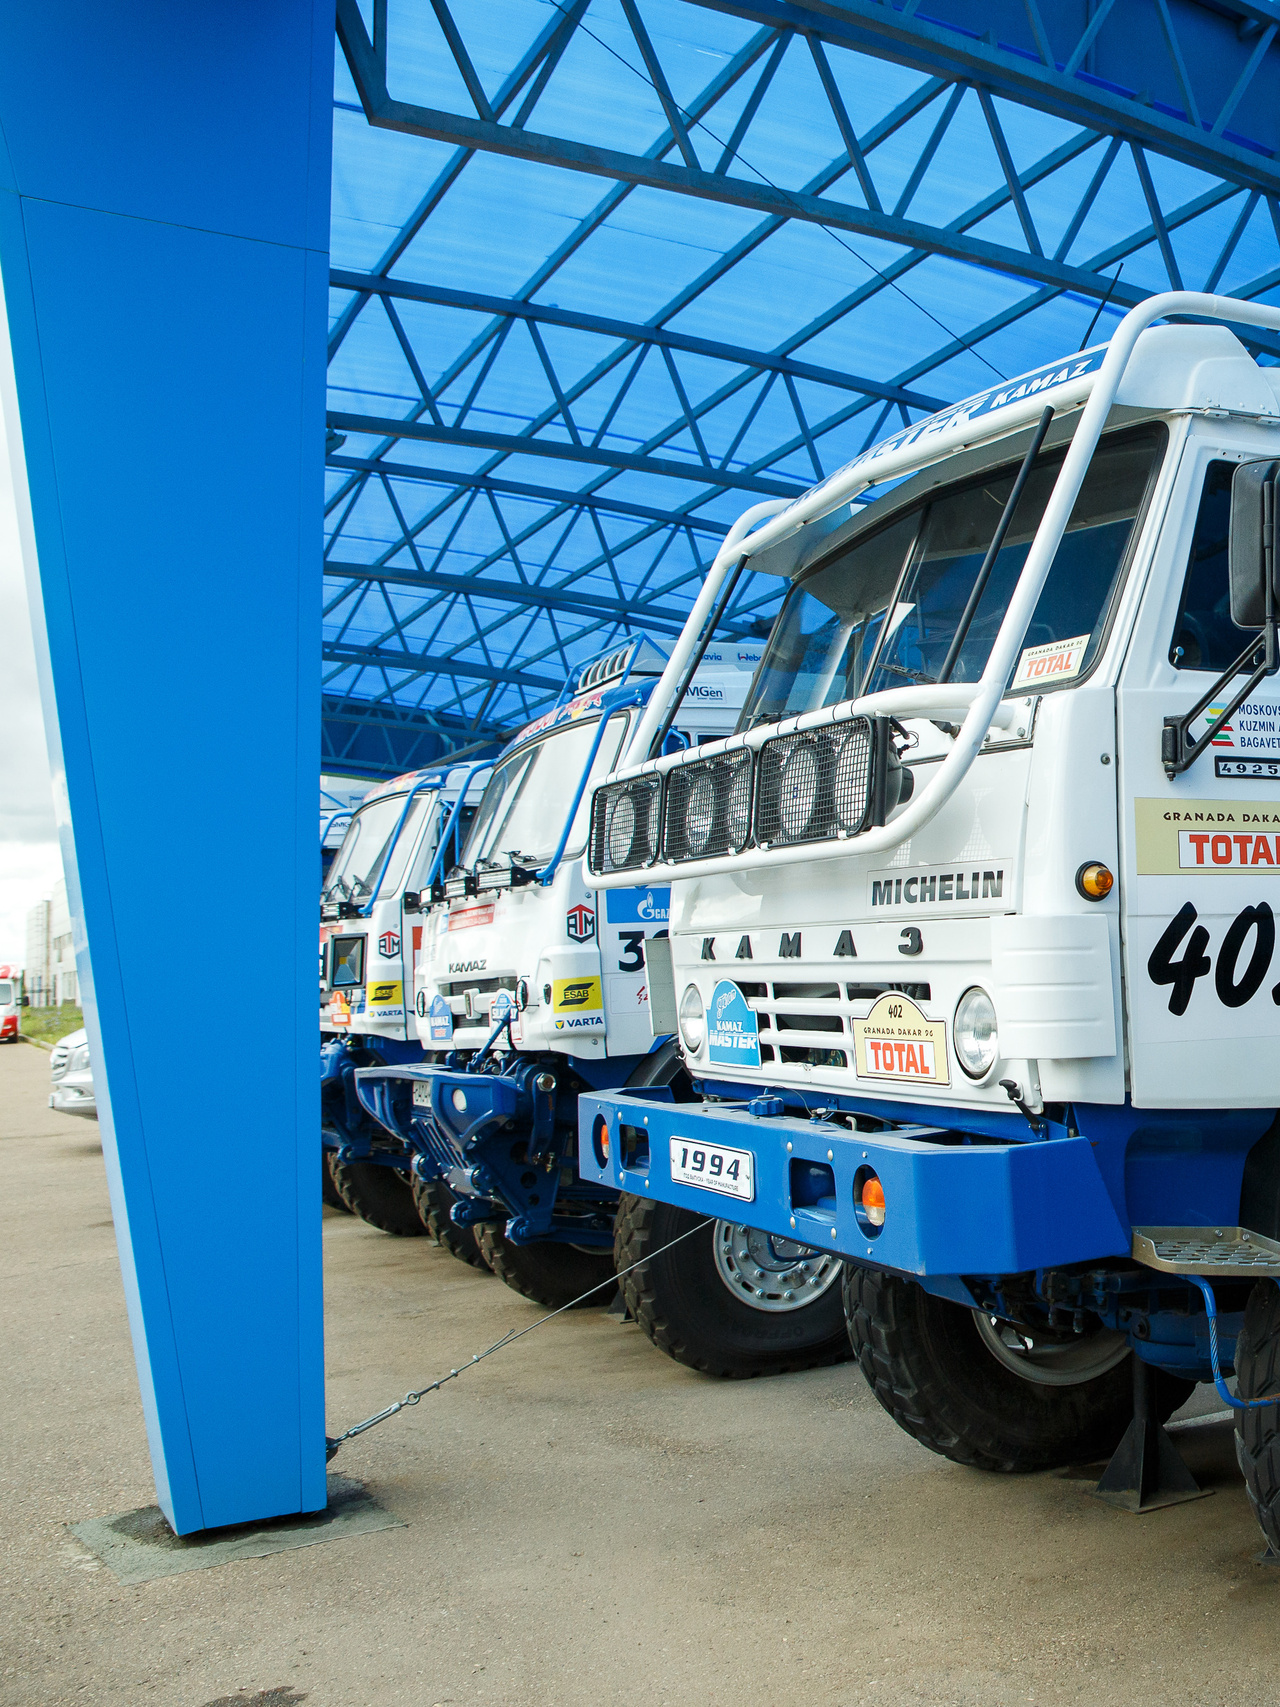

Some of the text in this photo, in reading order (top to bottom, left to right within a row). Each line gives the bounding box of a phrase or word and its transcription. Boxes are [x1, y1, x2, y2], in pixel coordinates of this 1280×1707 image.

[989, 358, 1093, 409] KAMAZ
[1027, 647, 1053, 657] GRANADA
[1055, 642, 1074, 651] DAKAR
[1026, 651, 1072, 678] TOTAL
[1239, 720, 1275, 732] KUZMIN
[1163, 811, 1236, 822] GRANADA
[871, 870, 1005, 907] MICHELIN
[618, 929, 669, 973] 3
[448, 959, 487, 974] KAMAZ
[563, 989, 589, 1000] ESAB
[888, 1004, 903, 1018] 402
[567, 1016, 603, 1028] VARTA
[716, 1020, 743, 1033] KAMAZ
[709, 1029, 757, 1049] MASTER
[863, 1027, 895, 1035] GRANADA
[897, 1028, 922, 1036] DAKAR
[870, 1041, 930, 1075] TOTAL
[681, 1147, 741, 1181] 1994
